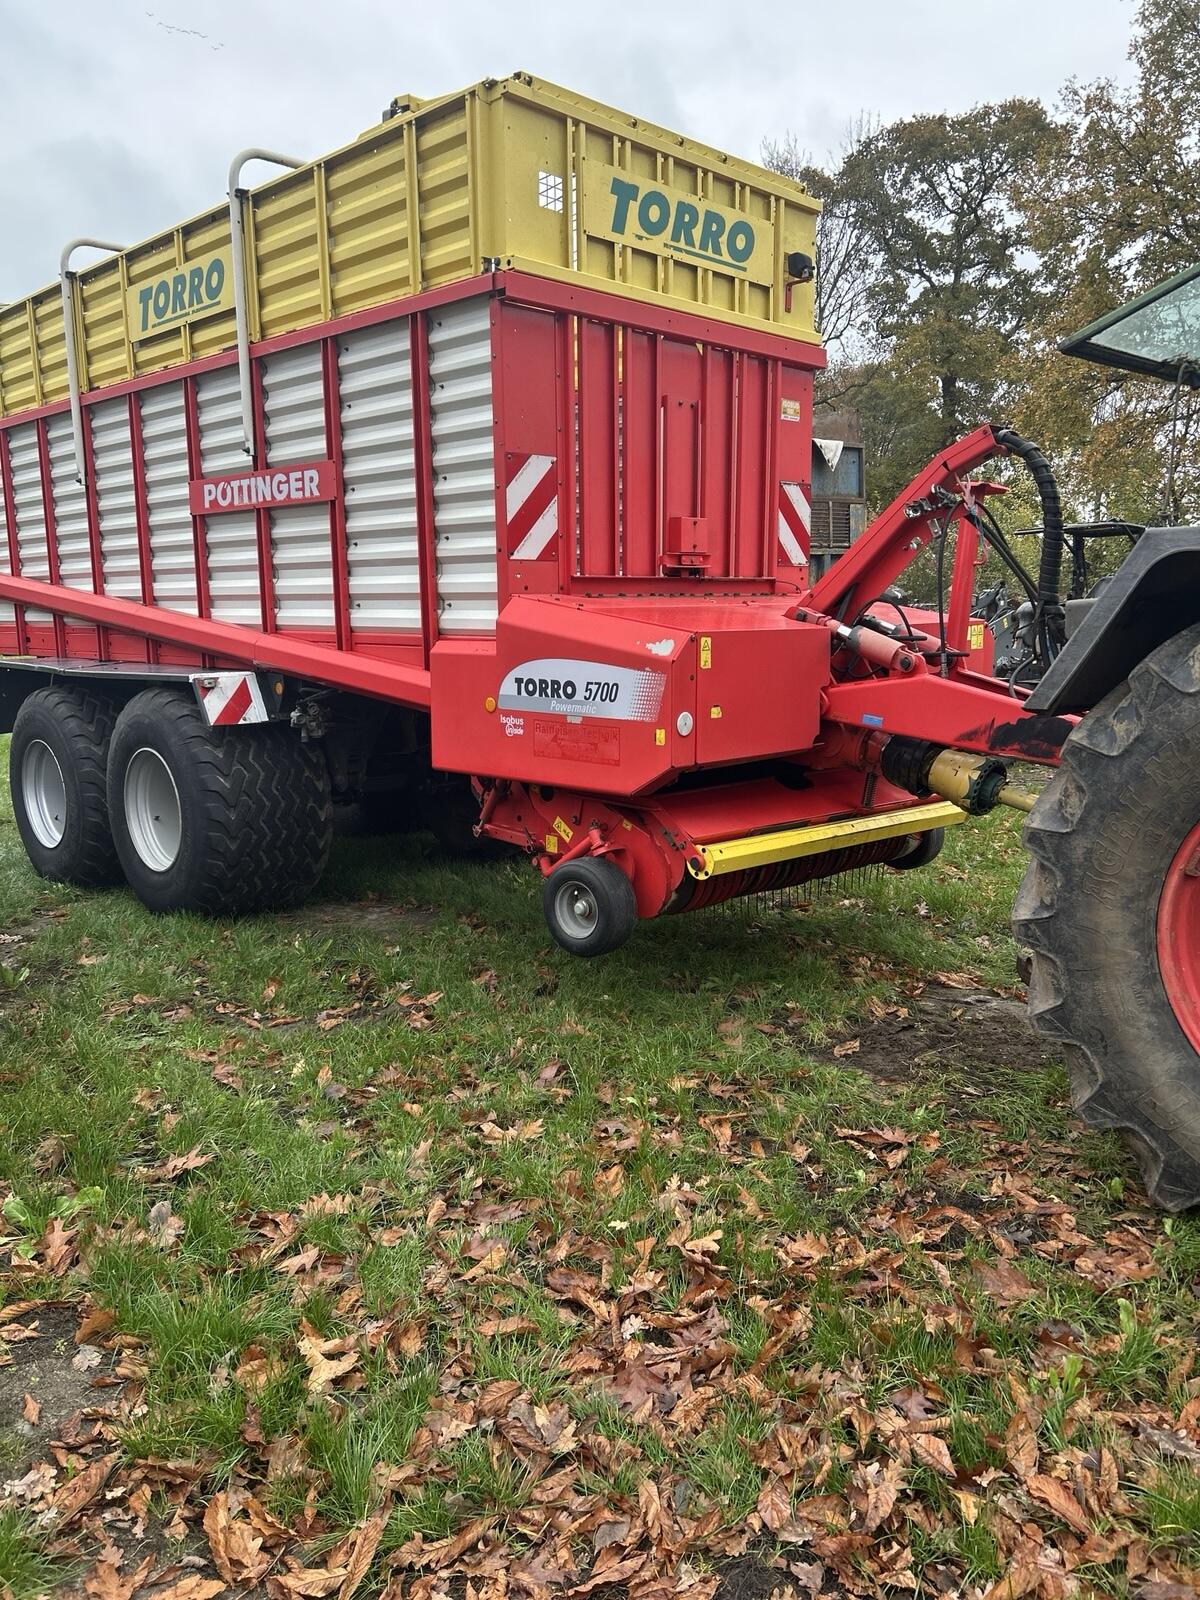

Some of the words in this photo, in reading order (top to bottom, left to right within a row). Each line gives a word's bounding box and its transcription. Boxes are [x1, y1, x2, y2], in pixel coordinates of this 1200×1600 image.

[611, 177, 755, 263] TORRO
[139, 258, 225, 332] TORRO
[515, 678, 577, 700] TORRO
[584, 682, 619, 702] 5700
[550, 700, 597, 714] Powermatic
[500, 714, 524, 726] Isobus
